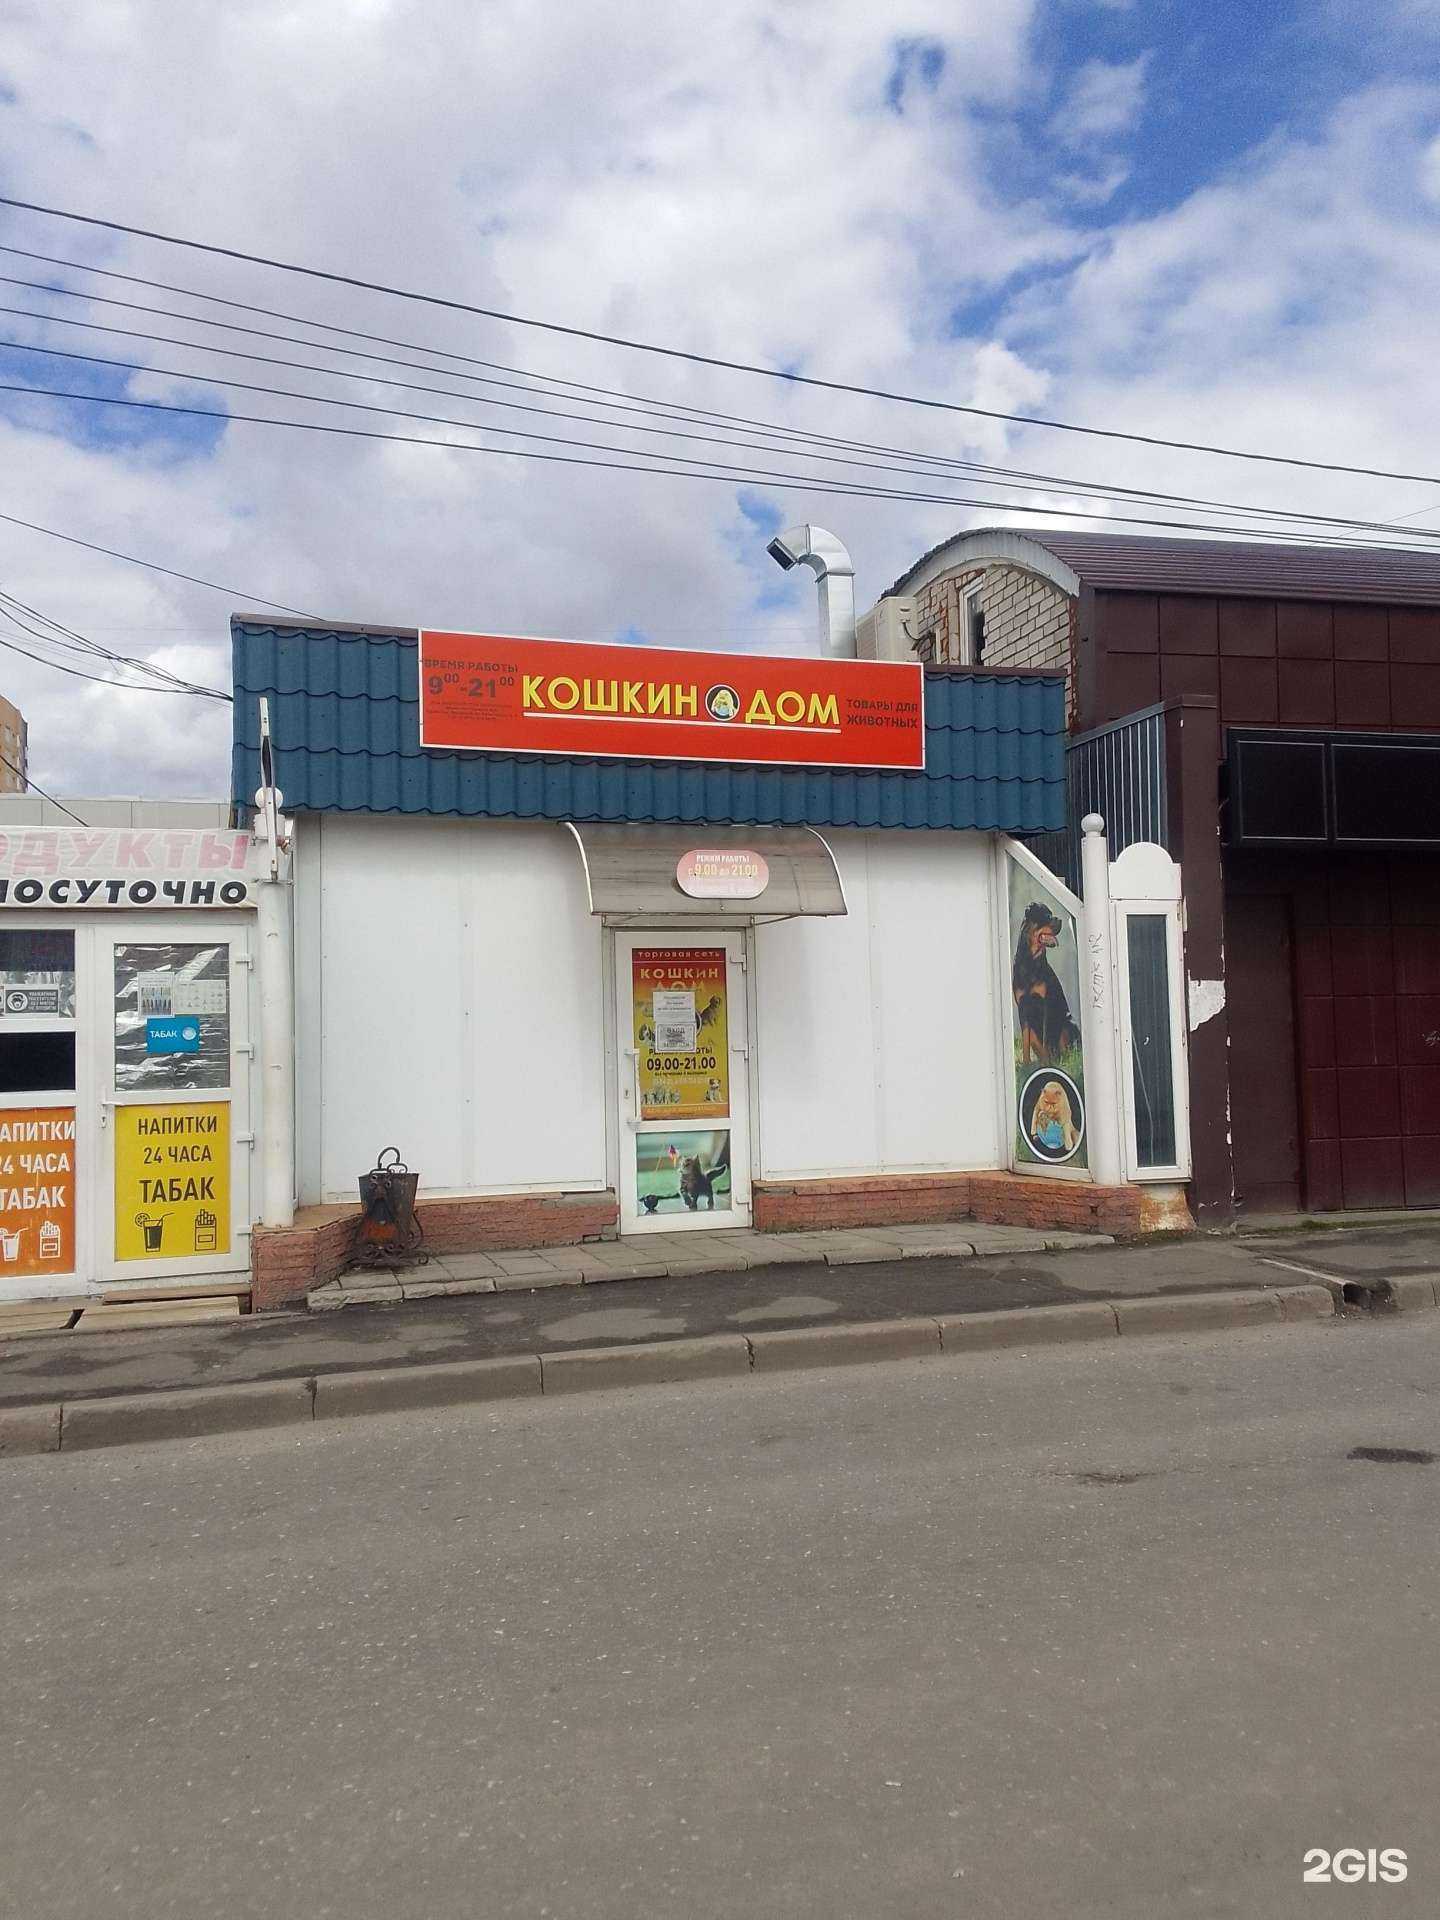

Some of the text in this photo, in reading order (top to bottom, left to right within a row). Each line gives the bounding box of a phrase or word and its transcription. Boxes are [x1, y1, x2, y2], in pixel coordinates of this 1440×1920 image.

[423, 659, 518, 673] ВРЕМЯ РАБОТЫ
[522, 675, 698, 717] КОШКИН
[745, 689, 840, 725] ДОМ
[846, 699, 918, 713] ТОВАРЫ ДЛЯ
[846, 715, 918, 729] ЖИВОТНЫХ
[639, 951, 691, 959] торговая
[640, 967, 718, 979] КОШКИН
[150, 1030, 178, 1038] ТАБАК
[647, 1057, 716, 1071] 09.00-21.00
[138, 1115, 217, 1135] НАПИТКИ
[143, 1145, 212, 1164] 24 ЧАСА
[20, 1152, 71, 1174] ЧАСА
[139, 1176, 215, 1204] ТАБАК
